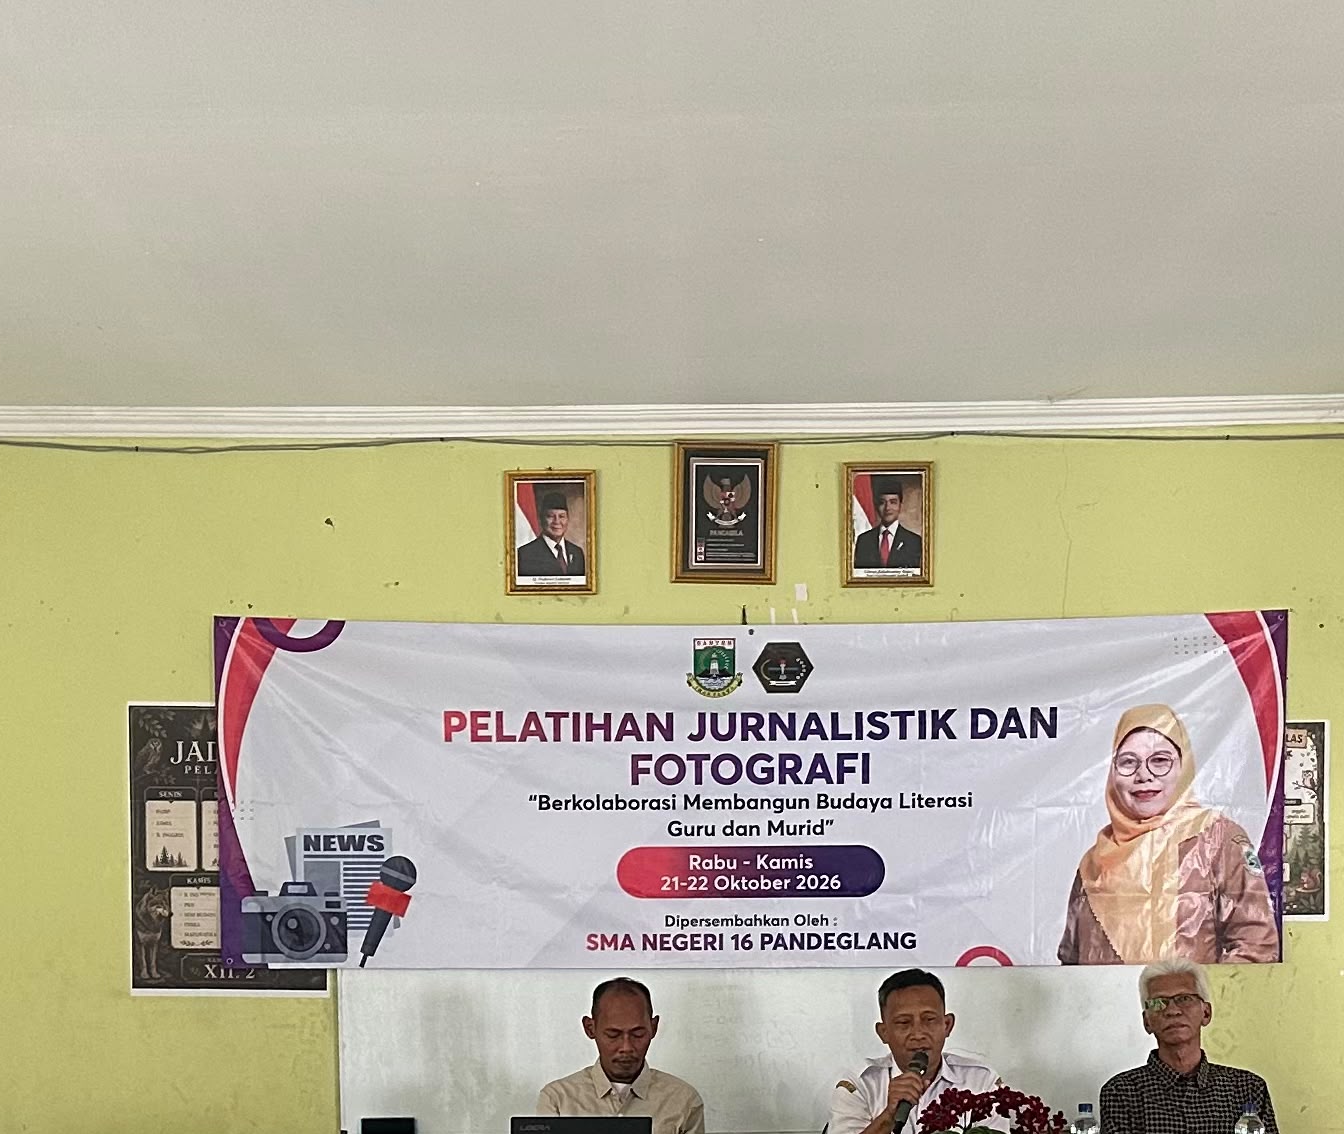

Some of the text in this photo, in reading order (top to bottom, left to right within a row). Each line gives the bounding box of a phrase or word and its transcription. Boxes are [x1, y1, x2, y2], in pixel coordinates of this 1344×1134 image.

[443, 706, 1058, 743] PELATIHAN JURNALISTIK DAN
[630, 752, 871, 786] FOTOGRAFI
[683, 793, 812, 813] Membangun
[817, 793, 894, 812] Budaya
[899, 792, 974, 809] Literasi
[667, 820, 716, 837] Guru
[721, 820, 761, 837] dan
[303, 835, 385, 852] NEWS
[689, 854, 737, 871] Rabu
[756, 854, 814, 871] Kamis
[660, 874, 841, 892] 21-22 Oktober 2026
[664, 914, 789, 930] Dipersembahkan
[793, 914, 830, 928] Oleh
[586, 932, 917, 951] SMA NEGERI 16 PANDEGLANG
[245, 968, 256, 979] 2
